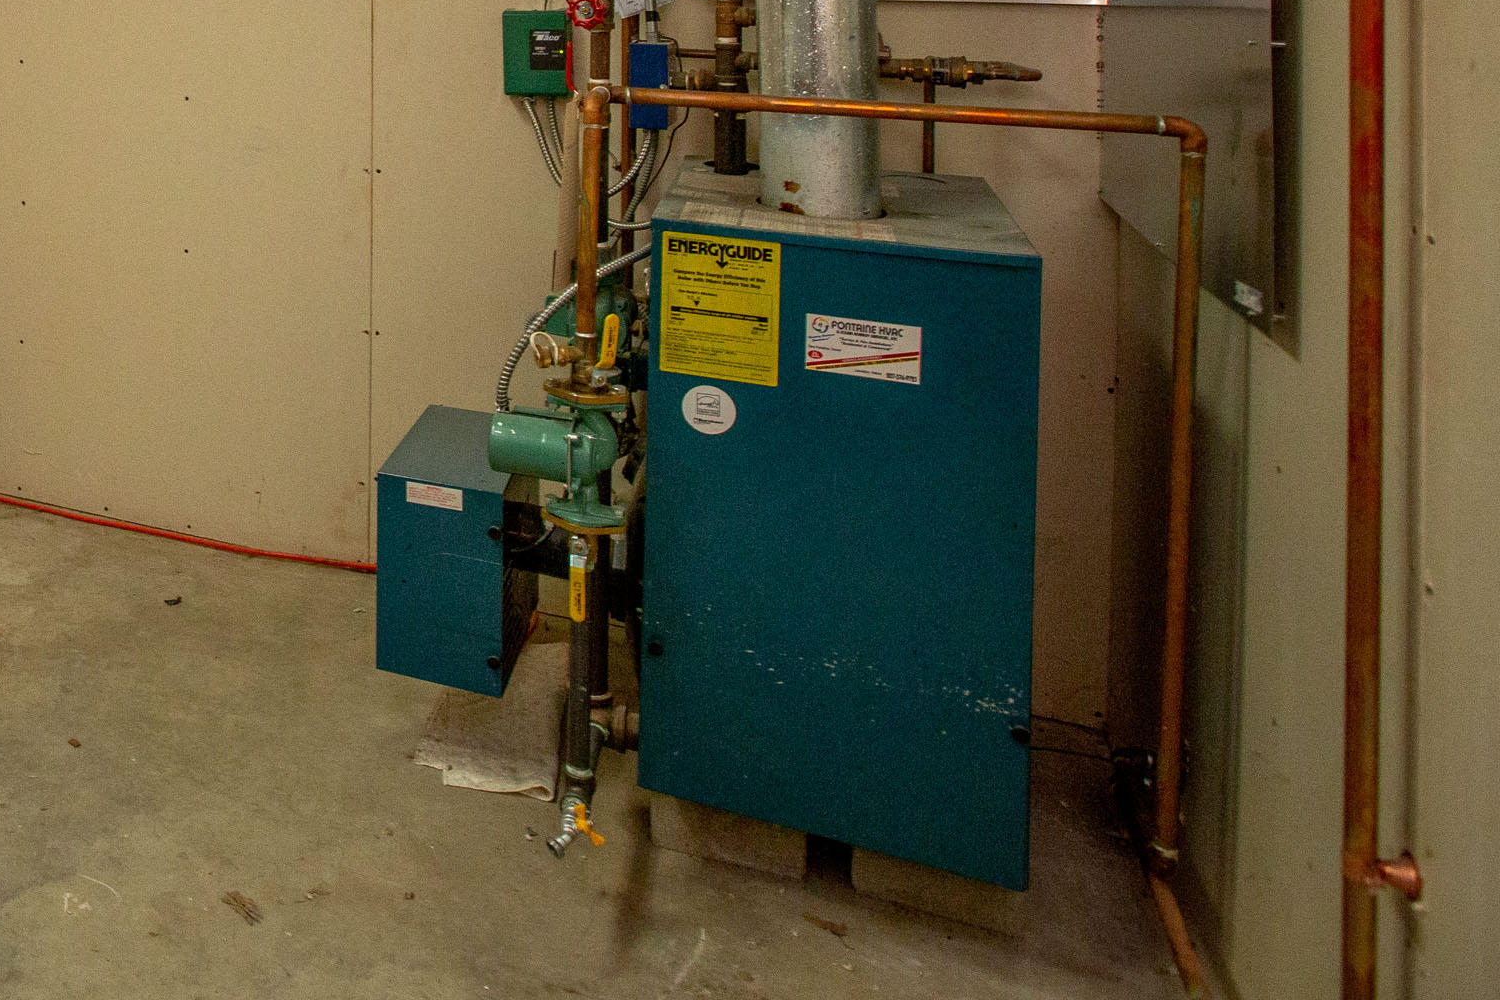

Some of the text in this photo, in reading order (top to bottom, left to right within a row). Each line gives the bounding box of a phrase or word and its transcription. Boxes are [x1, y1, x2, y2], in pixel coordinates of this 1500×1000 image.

[668, 238, 773, 262] ENERGYGUIDE
[831, 320, 877, 334] FONTAINE
[878, 326, 905, 338] HVAC
